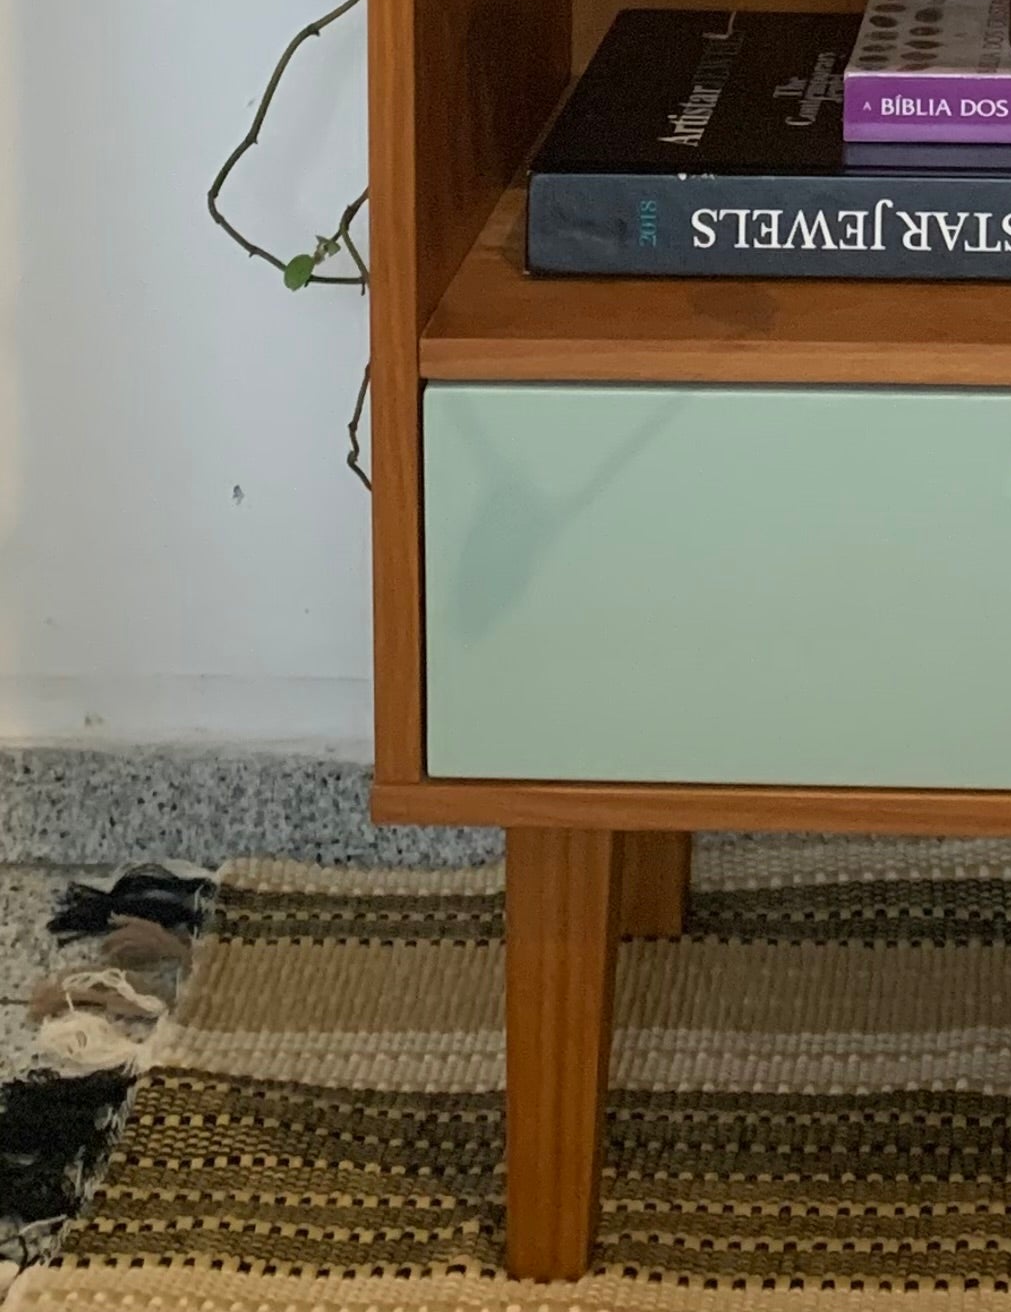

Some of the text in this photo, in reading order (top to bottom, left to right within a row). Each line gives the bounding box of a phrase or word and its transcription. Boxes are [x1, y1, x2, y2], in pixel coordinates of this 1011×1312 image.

[657, 85, 722, 147] Artistar
[863, 101, 872, 111] A
[880, 95, 952, 119] BÍBLIA
[960, 99, 1009, 118] DOS
[637, 199, 658, 249] 2018
[691, 198, 893, 251] JEWELS
